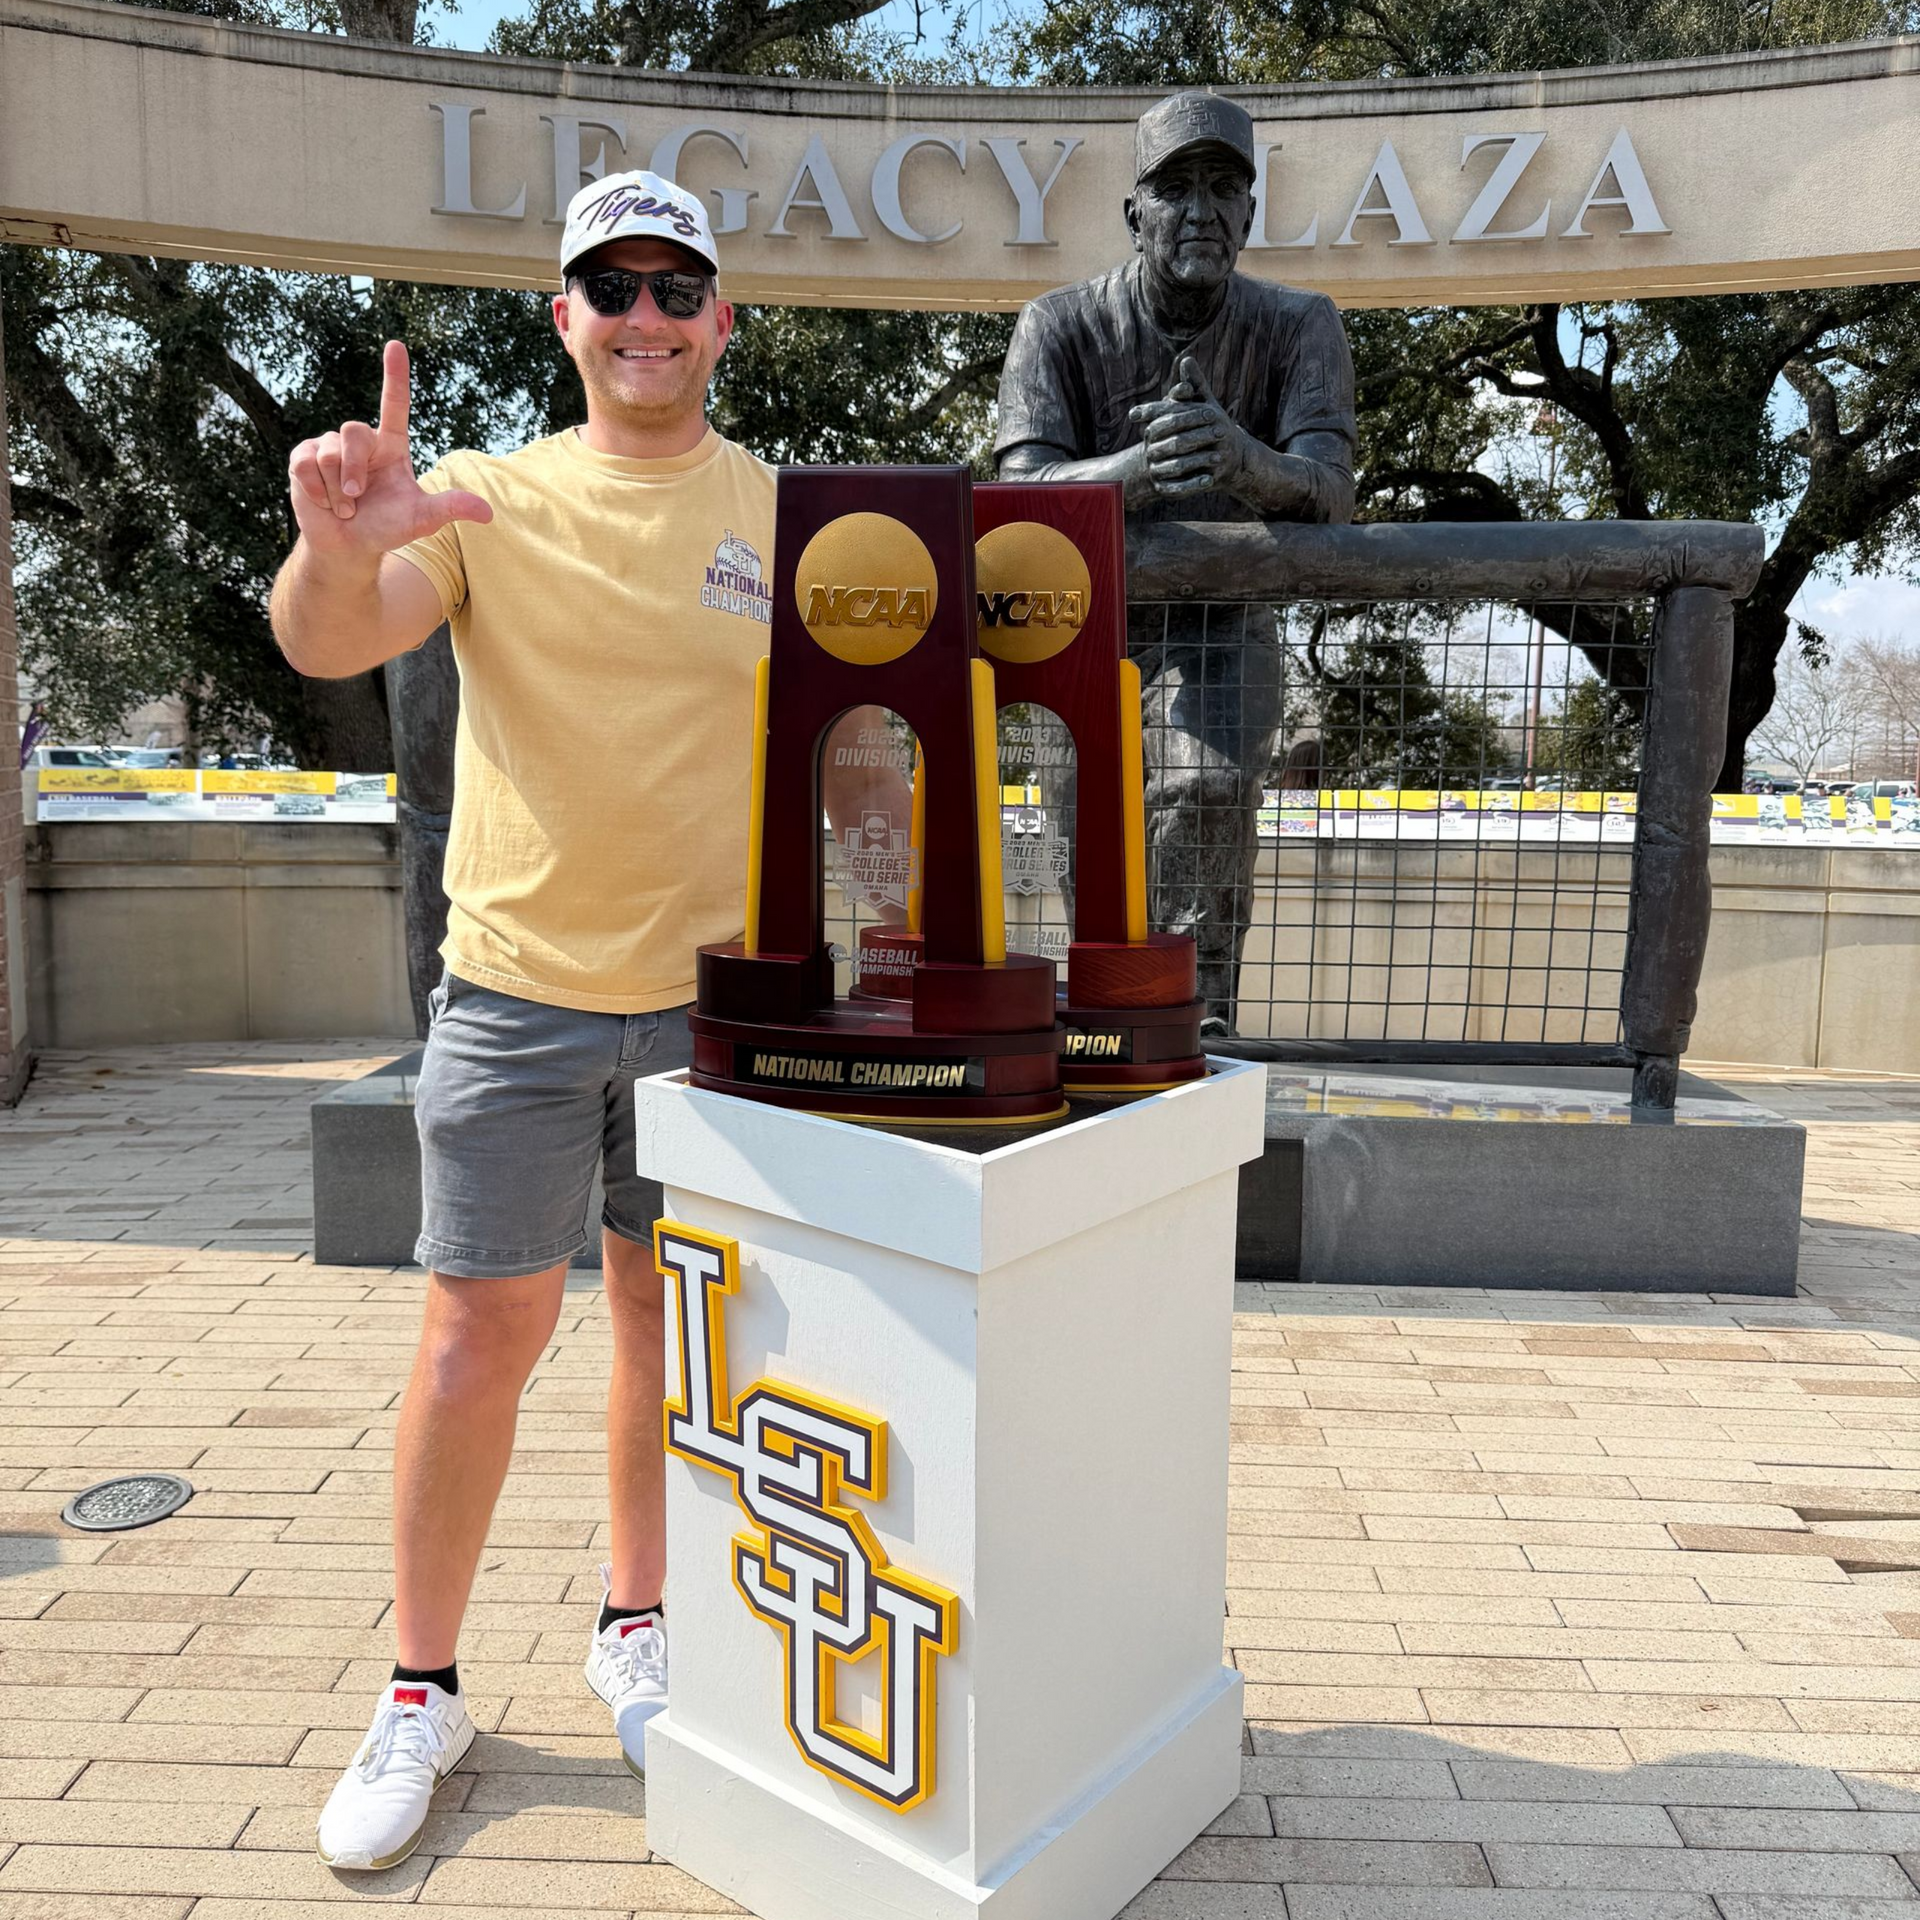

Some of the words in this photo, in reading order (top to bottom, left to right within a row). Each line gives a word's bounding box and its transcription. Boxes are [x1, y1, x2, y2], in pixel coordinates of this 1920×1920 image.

[429, 103, 1084, 248] LEGACY
[1243, 126, 1673, 251] LAZA
[577, 184, 702, 237] Tigers
[725, 528, 754, 576] LSU
[705, 566, 772, 601] NATIONAL
[701, 585, 773, 625] CHAMPION
[805, 584, 930, 629] NCAA
[976, 590, 1087, 629] NCAA
[1010, 726, 1052, 743] 203
[834, 747, 912, 769] DIVISION
[867, 826, 887, 835] NCAA
[851, 856, 900, 871] COLLEGE
[863, 883, 889, 892] OMAHA
[1005, 929, 1069, 946] BAEBALL
[850, 946, 918, 965] BASEBALL
[753, 1053, 845, 1083] NATIONAL
[850, 1062, 966, 1088] CHAMPION
[653, 1218, 959, 1815] LSU
